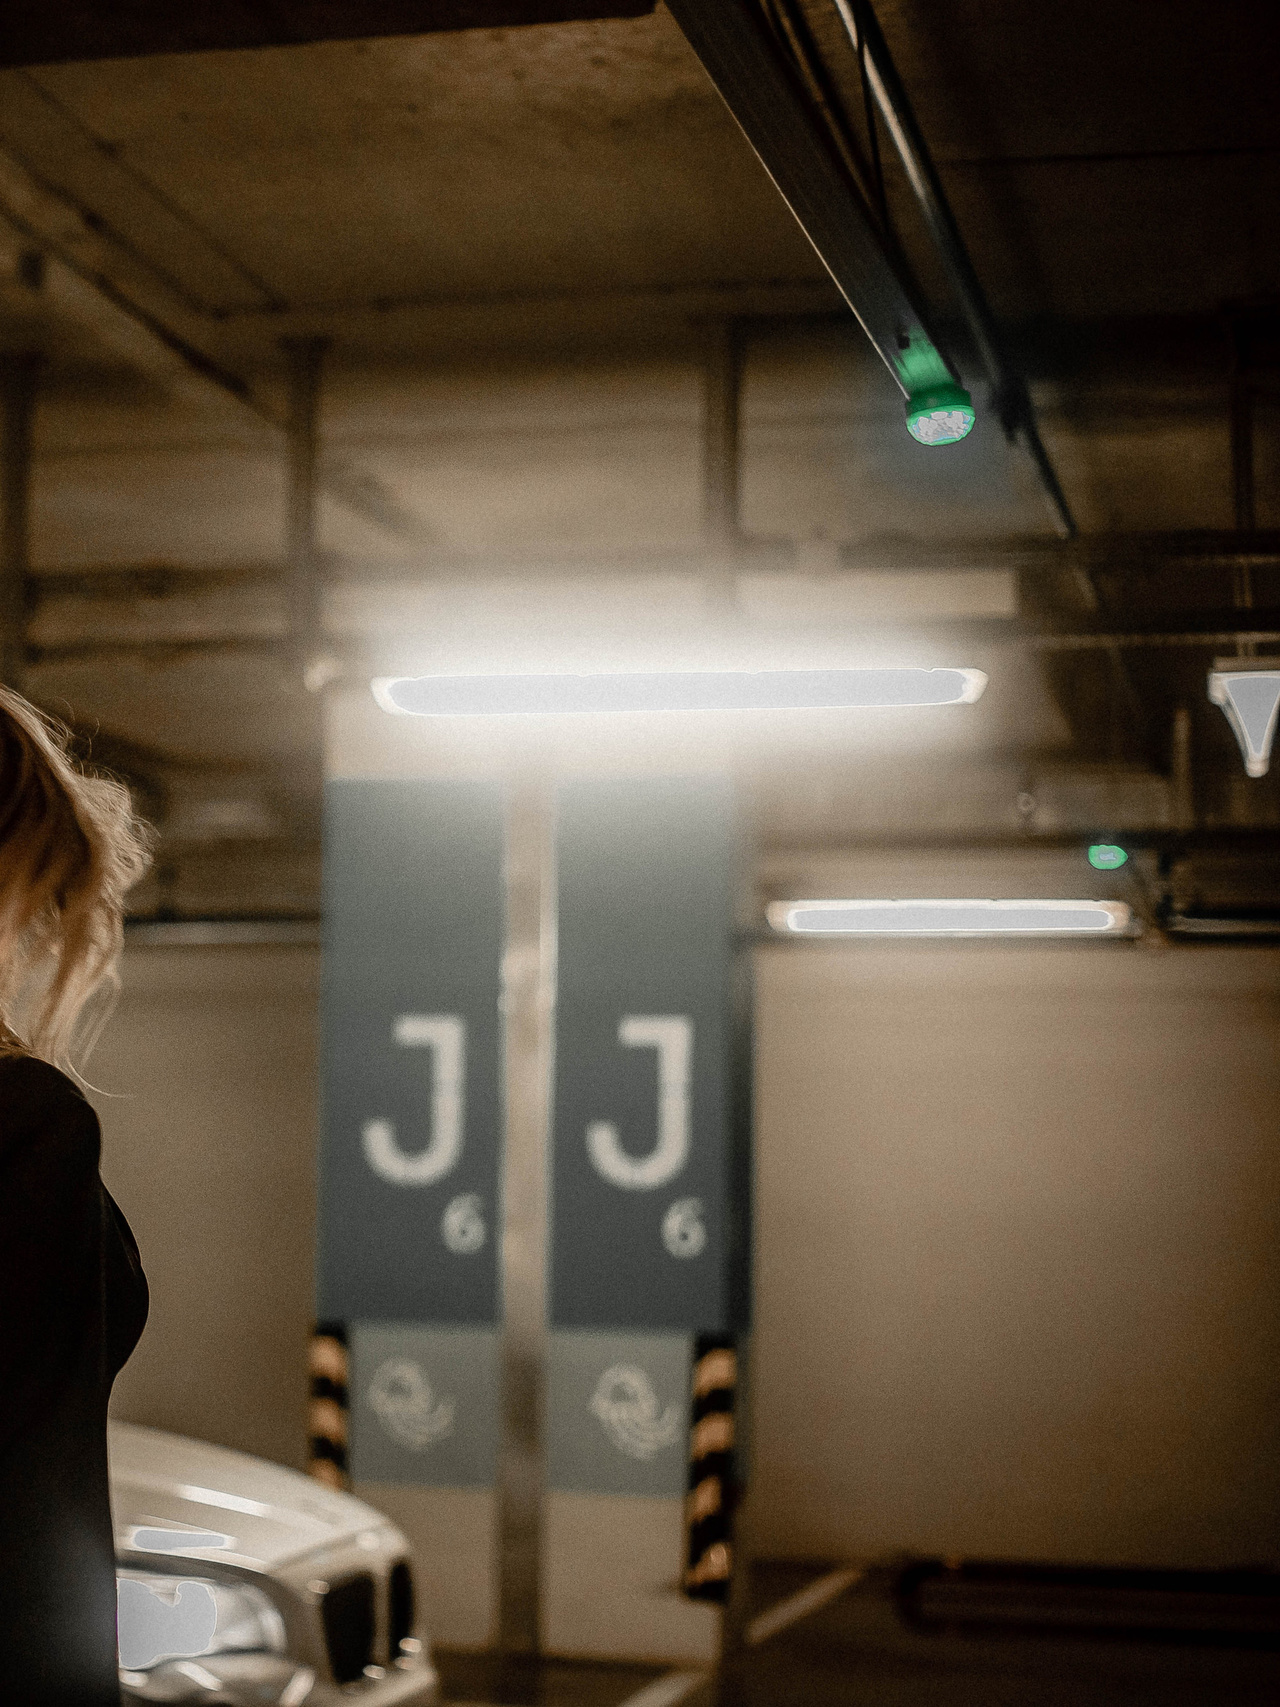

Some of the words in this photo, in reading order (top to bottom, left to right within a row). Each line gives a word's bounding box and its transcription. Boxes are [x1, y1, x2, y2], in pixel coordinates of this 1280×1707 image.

[363, 1015, 464, 1186] J
[587, 1015, 693, 1189] J
[442, 1195, 486, 1253] 6
[663, 1198, 706, 1259] 6
